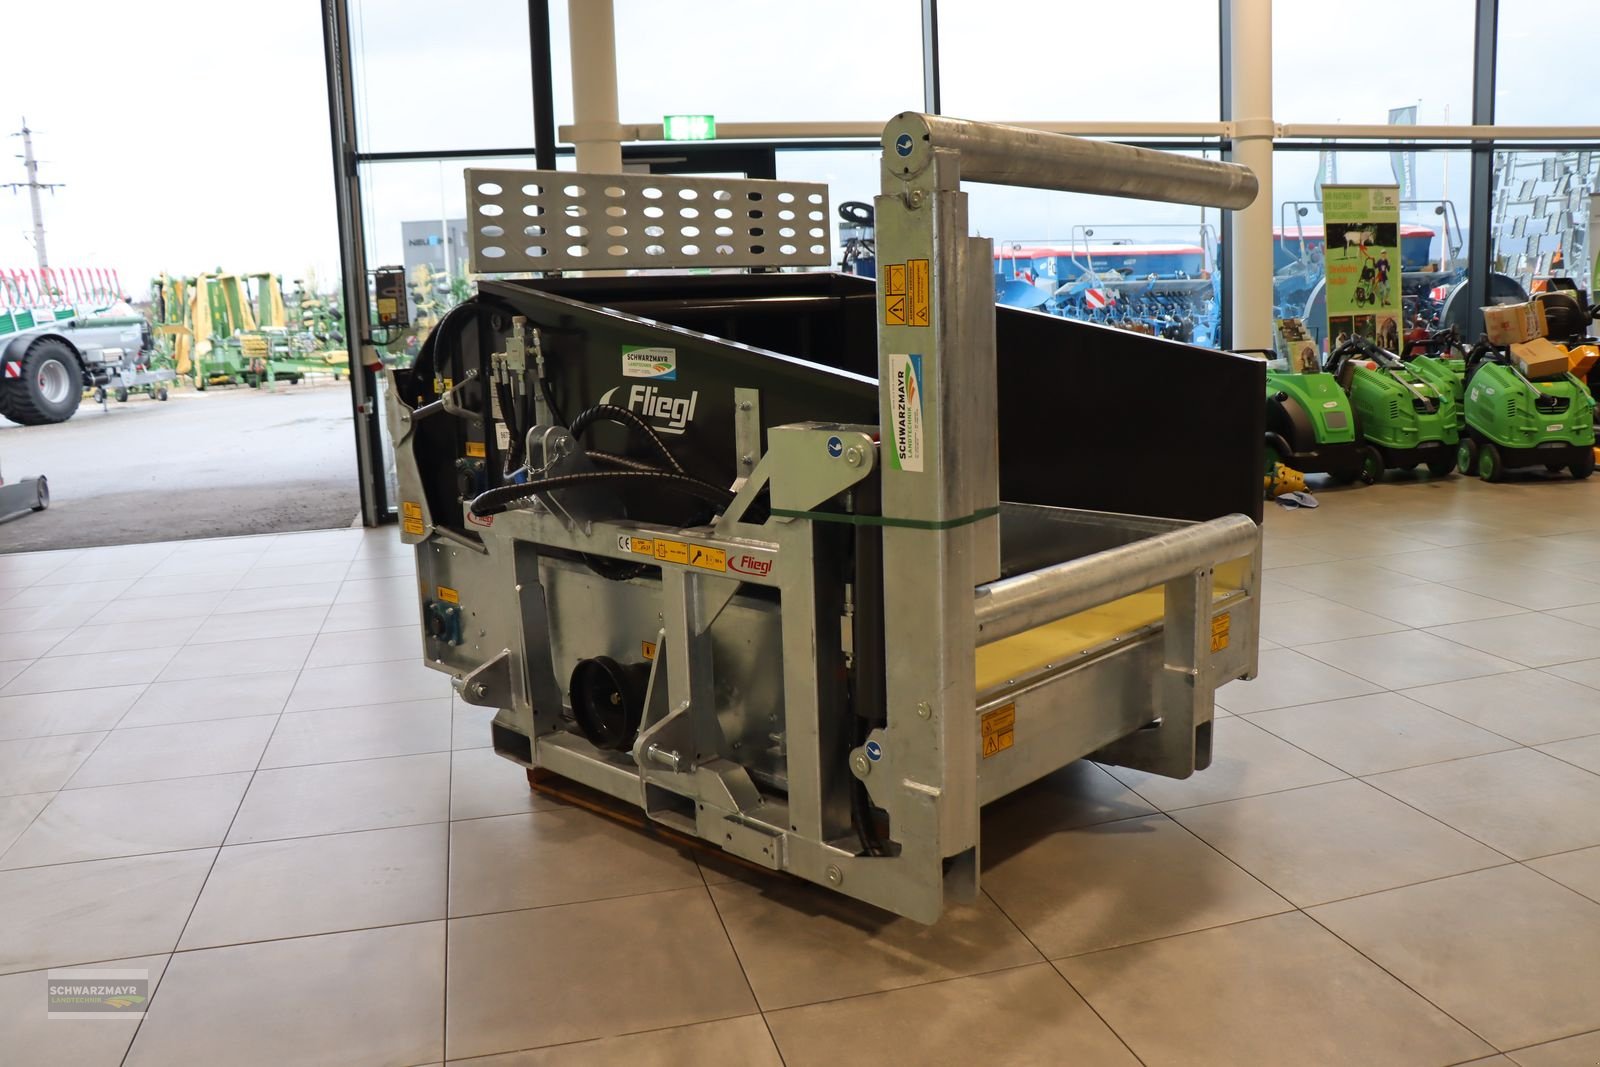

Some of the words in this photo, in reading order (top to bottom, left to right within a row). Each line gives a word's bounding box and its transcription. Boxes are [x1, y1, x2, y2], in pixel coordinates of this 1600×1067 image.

[627, 354, 668, 362] SCHWARZMAYR
[628, 384, 698, 428] Fliegl
[898, 371, 906, 460] SCHWARZMAYR
[741, 555, 773, 574] Fliegl
